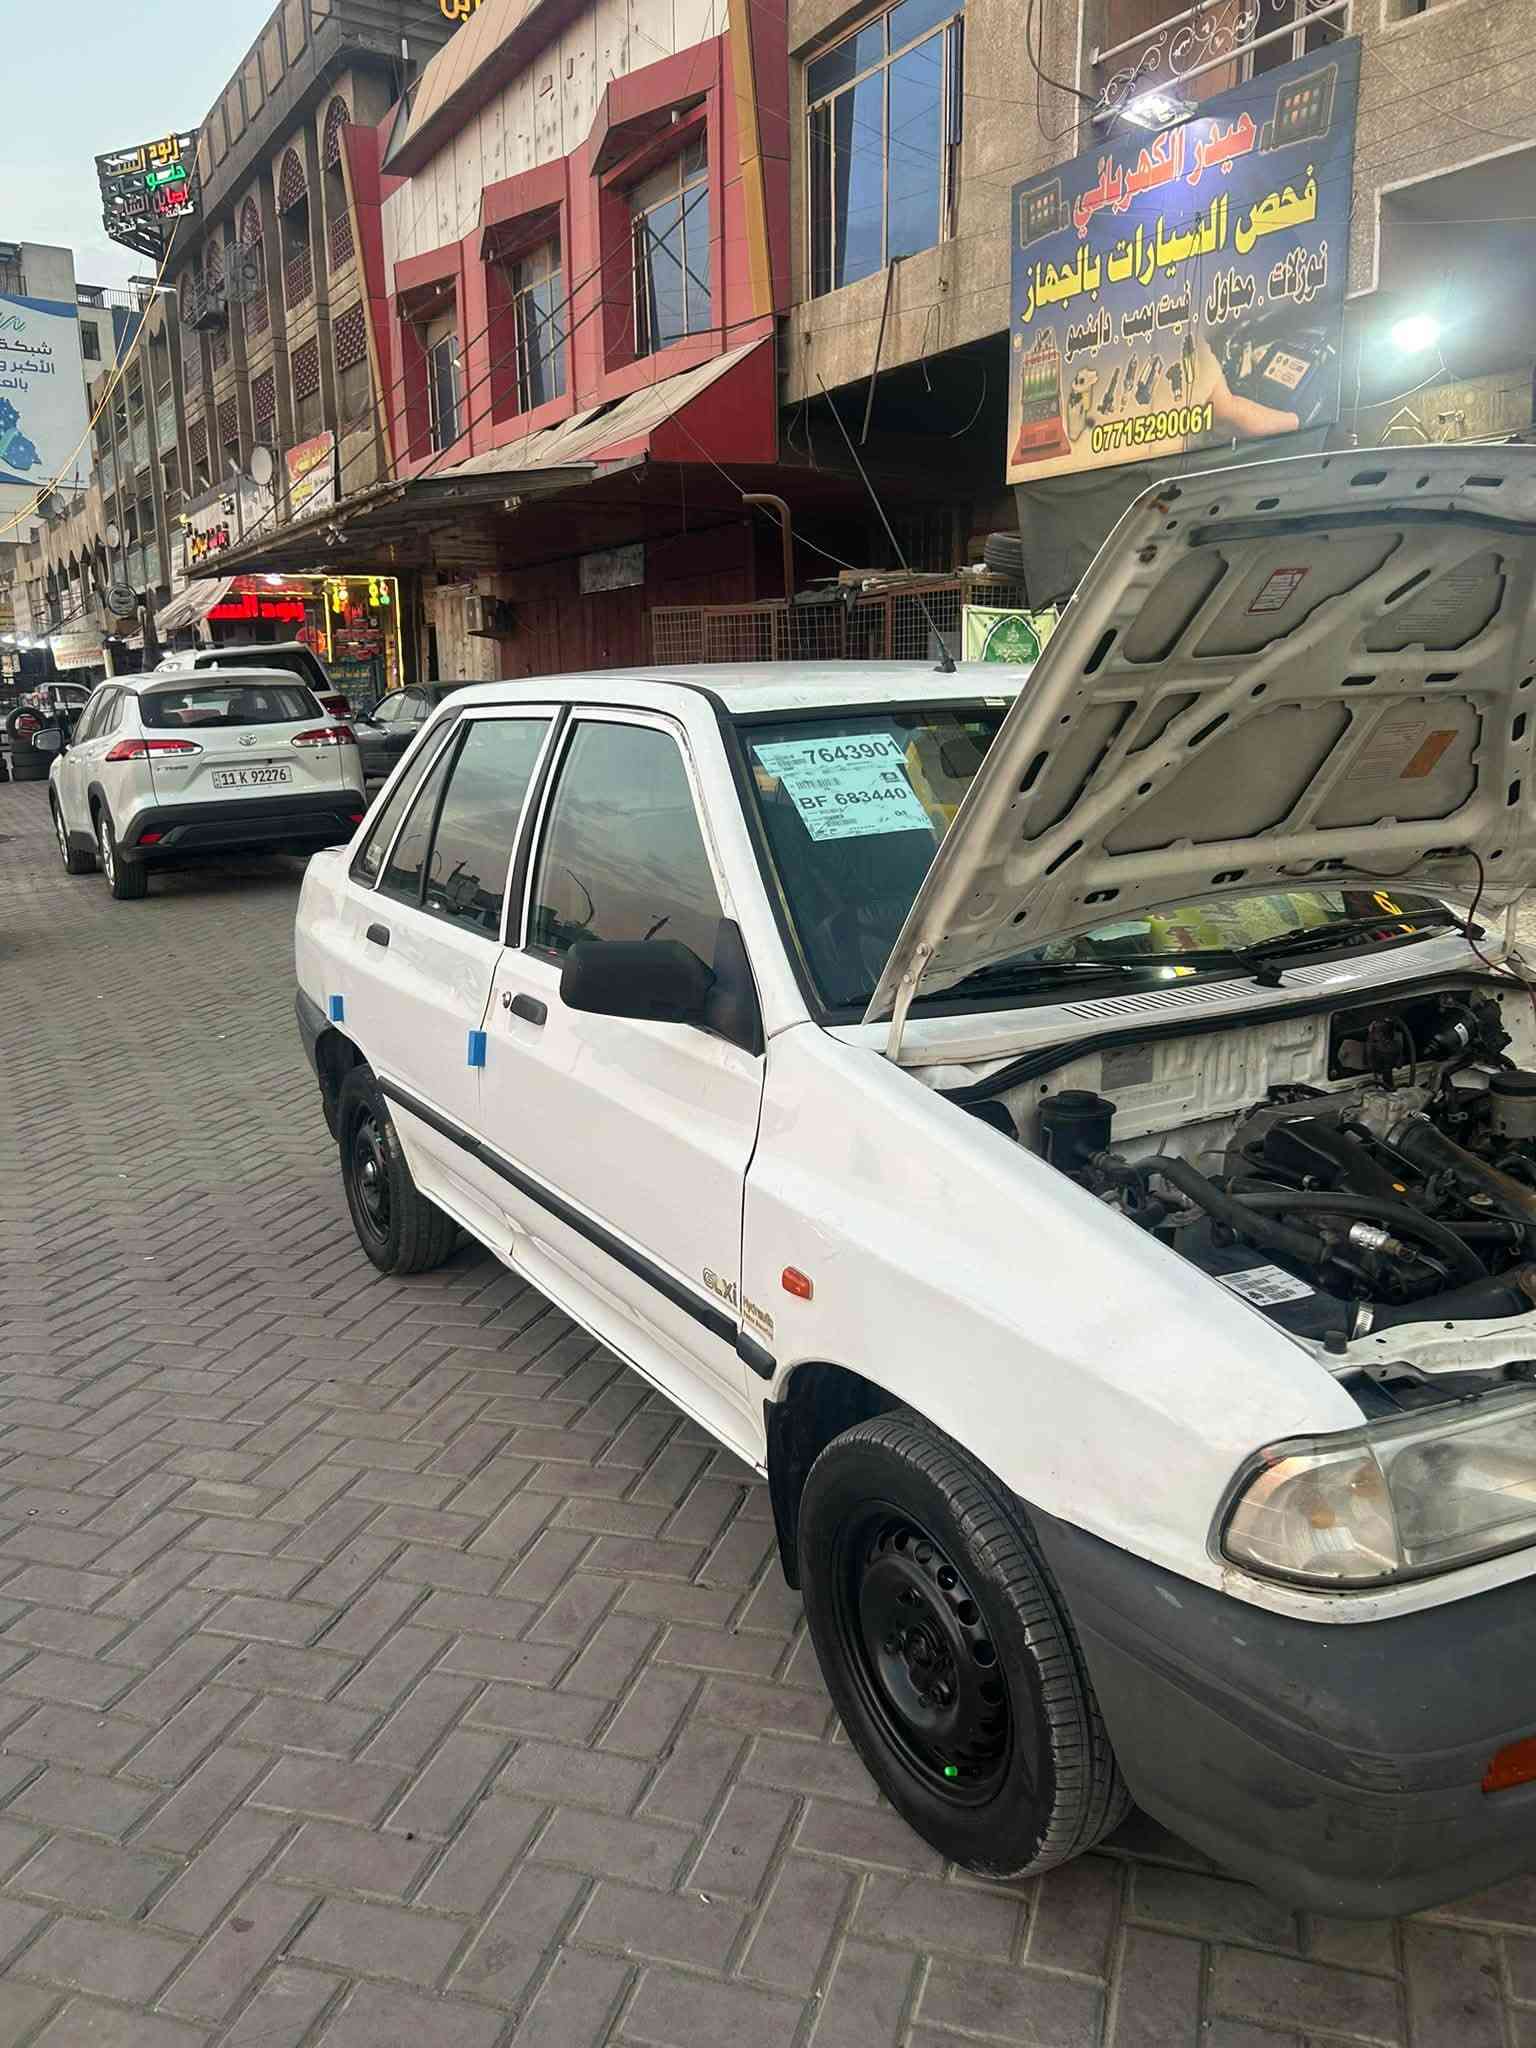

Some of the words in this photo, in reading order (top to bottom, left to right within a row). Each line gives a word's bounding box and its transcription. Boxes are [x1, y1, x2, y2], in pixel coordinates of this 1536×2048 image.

[1073, 125, 1186, 240] الكهربائي
[1187, 112, 1256, 186] حيدر
[1106, 192, 1229, 286] السيارات
[1234, 163, 1319, 256] فحص
[1020, 243, 1104, 326] بالجهاز
[1091, 401, 1214, 454] 07715290061
[221, 772, 236, 786] 11
[239, 770, 249, 784] K
[251, 768, 287, 783] 92276
[798, 794, 829, 811] BF
[834, 786, 908, 806] 683440
